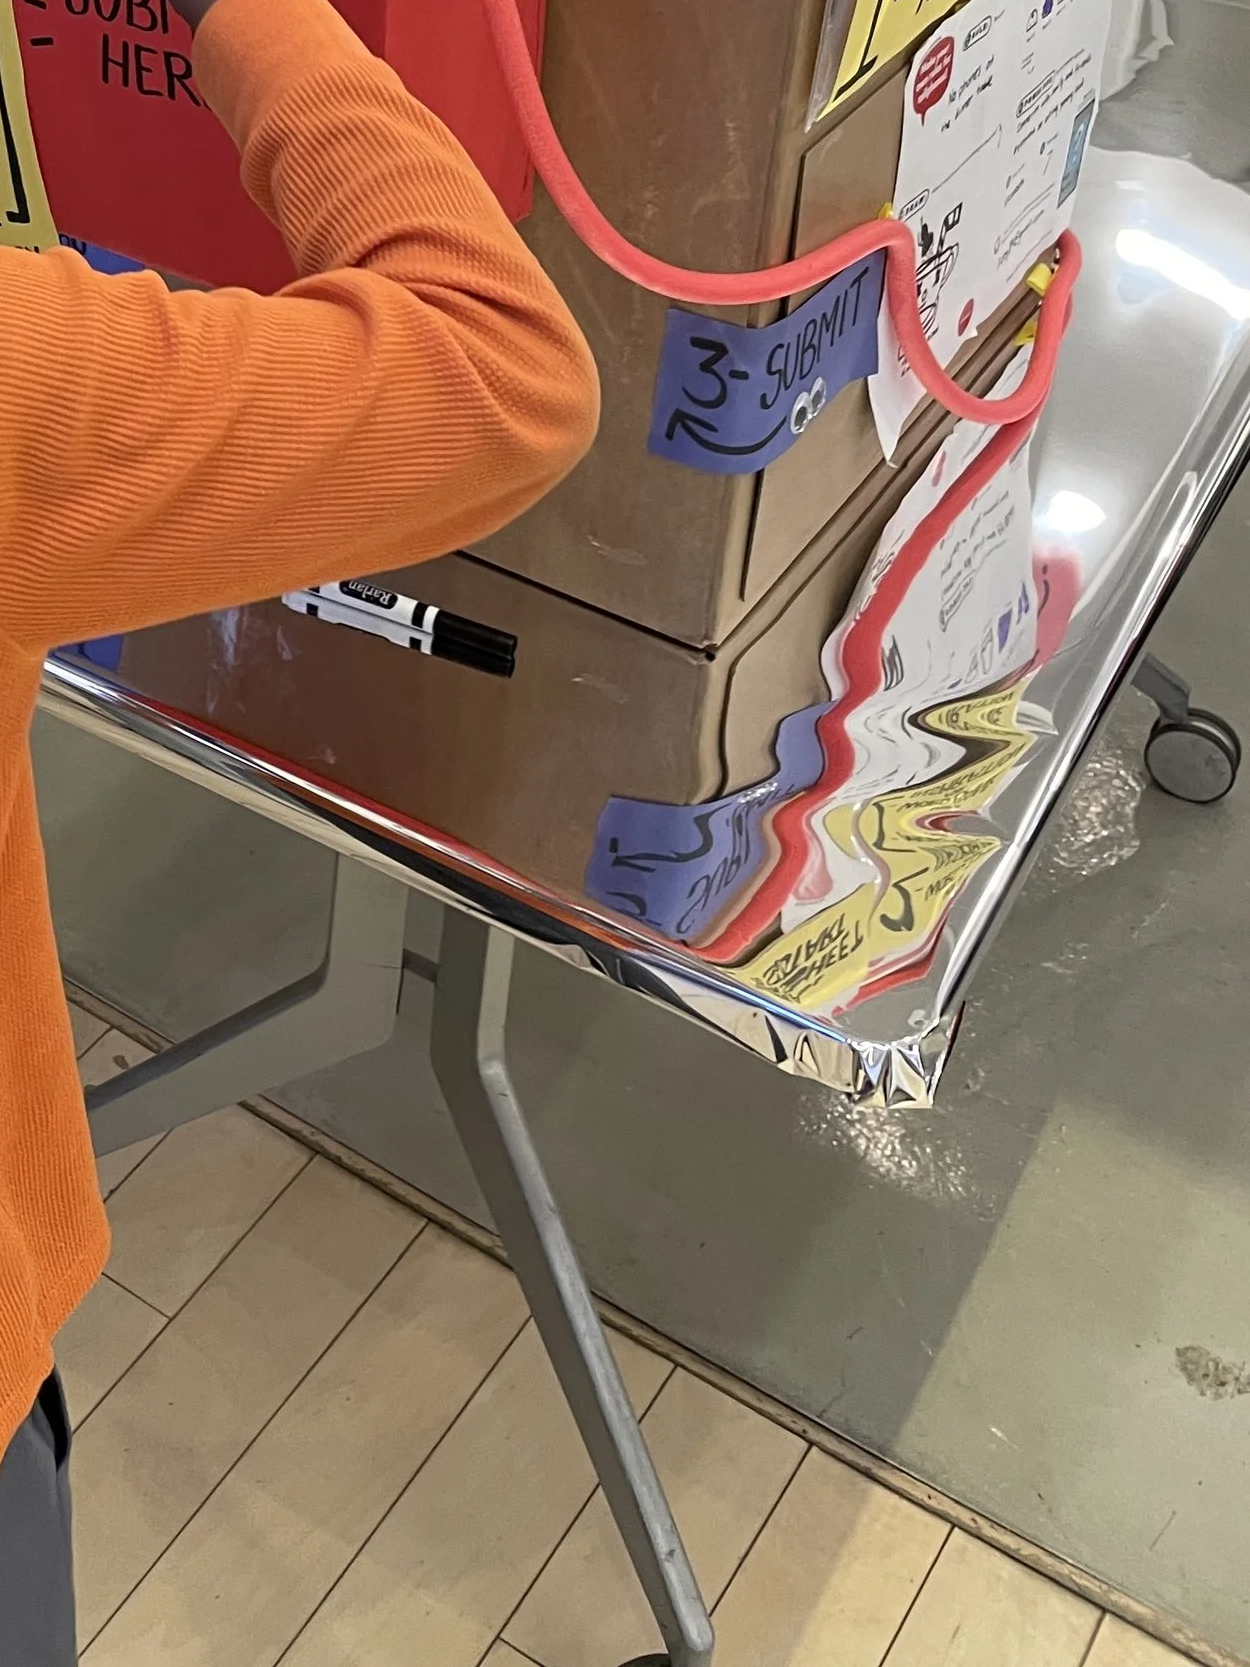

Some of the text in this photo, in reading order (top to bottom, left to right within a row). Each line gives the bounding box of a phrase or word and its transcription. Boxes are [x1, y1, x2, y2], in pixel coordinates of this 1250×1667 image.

[102, 33, 212, 112] HER
[759, 266, 870, 410] SUBMIT
[348, 580, 393, 606] Rarlan
